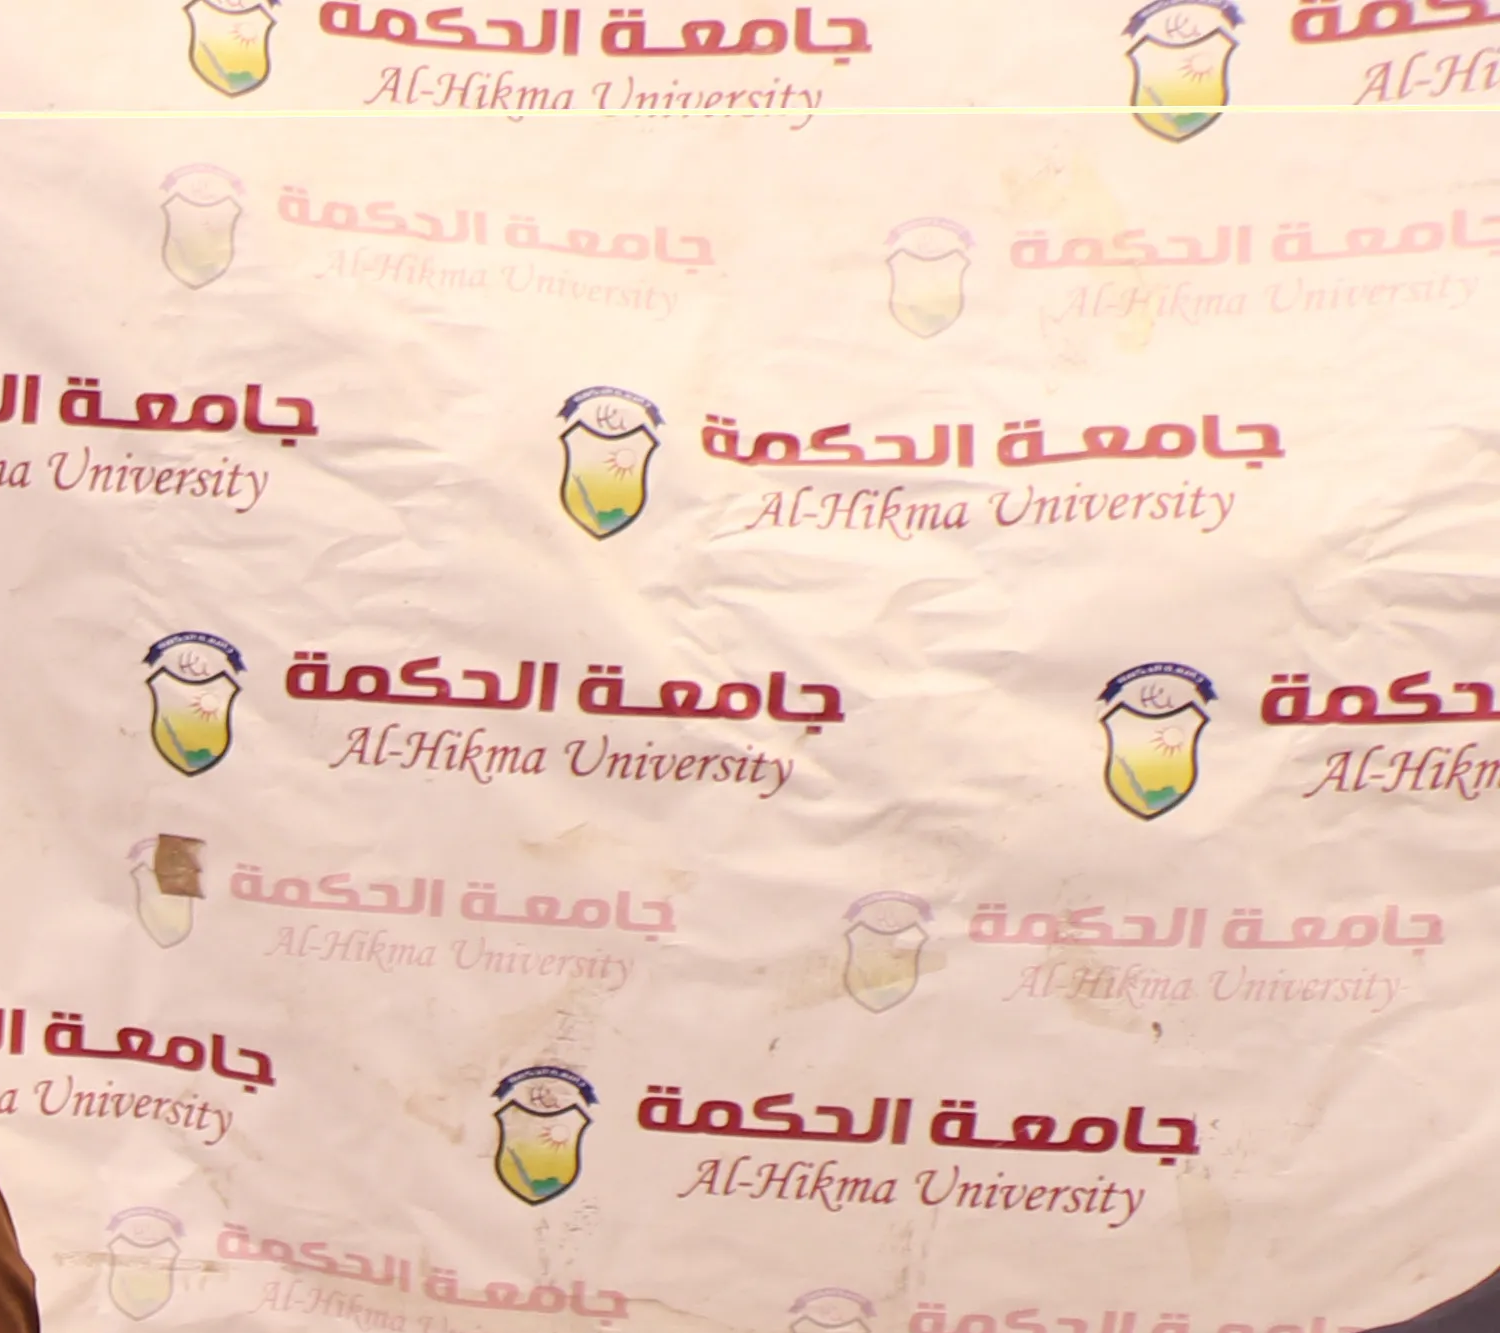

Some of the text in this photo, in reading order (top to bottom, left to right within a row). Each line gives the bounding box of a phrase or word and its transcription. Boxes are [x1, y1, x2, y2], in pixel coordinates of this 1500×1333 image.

[600, 3, 872, 66] جامعة
[275, 184, 716, 270] جامعة الحكمة
[1010, 225, 1252, 268] الحكمة
[59, 375, 318, 447] جامعة
[699, 411, 1287, 472] جامعة الحكمة
[47, 450, 270, 514] University
[745, 481, 1235, 543] Al-Hikma University
[284, 651, 845, 734] جامعة الحكمة
[329, 724, 795, 800] Al-Hikma University
[1303, 743, 1500, 800] Al-Hikm
[230, 864, 678, 943] جامعة الحكمة
[968, 902, 1445, 955] جامعة الحكمة
[44, 1009, 276, 1088] جامعة
[31, 1079, 234, 1146] University
[637, 1084, 1200, 1167] جامعة الحكمة
[677, 1158, 1146, 1229] Al-Hikma University
[215, 1222, 629, 1329] جامعة الحكمة
